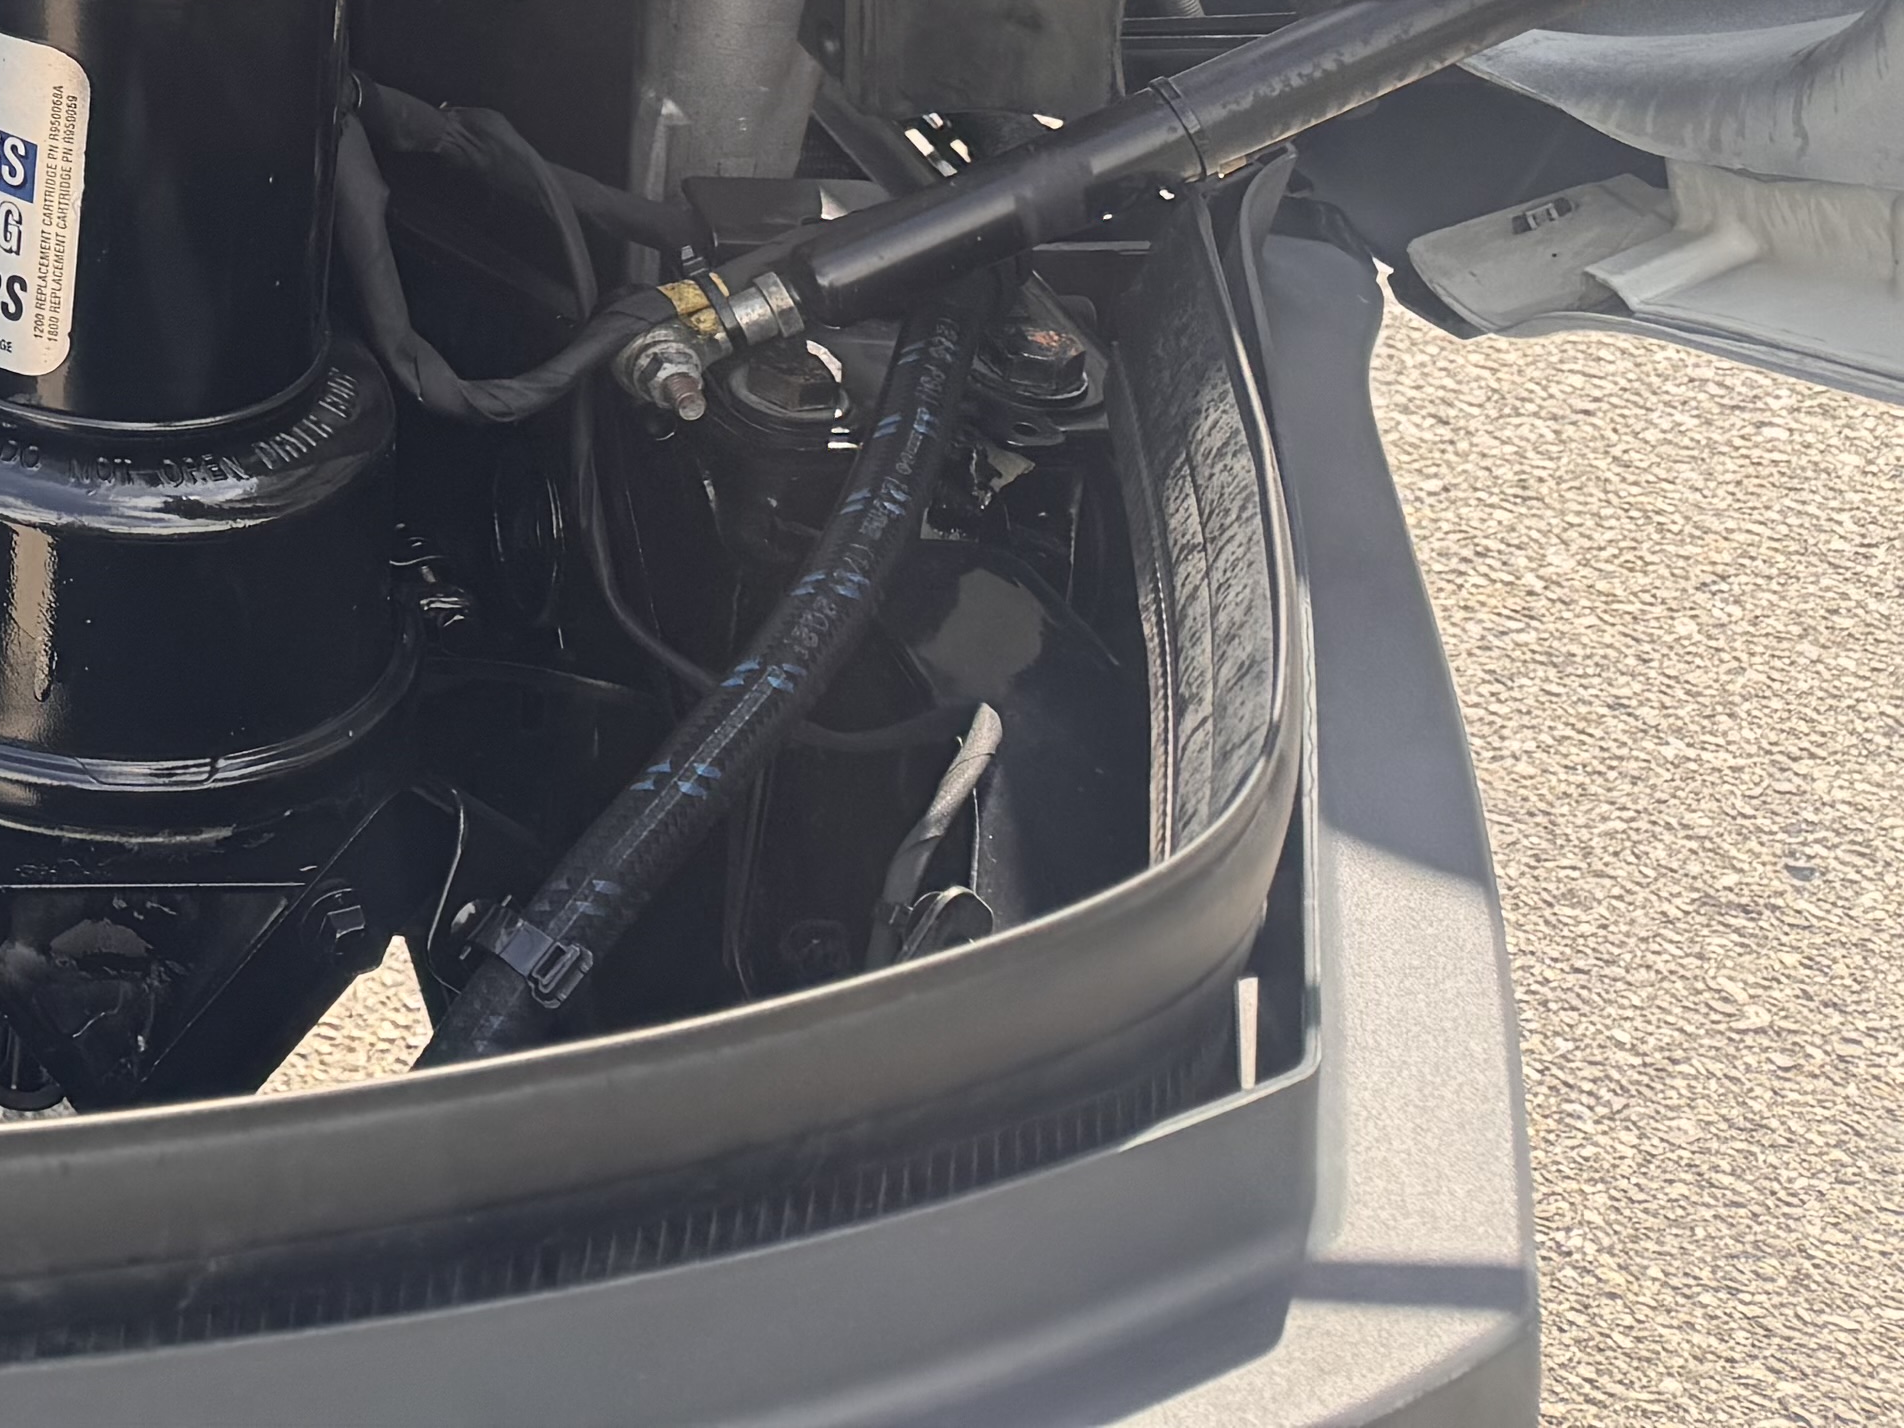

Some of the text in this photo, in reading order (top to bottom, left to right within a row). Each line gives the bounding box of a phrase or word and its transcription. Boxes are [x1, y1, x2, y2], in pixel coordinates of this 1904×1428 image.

[48, 144, 59, 161] PN
[43, 162, 58, 228] CARTRIDGE
[58, 165, 73, 231] CARTRIDGE
[35, 231, 52, 311] REPLACEMENT
[50, 234, 67, 316] REPLACEMENT
[33, 313, 46, 340] 1200
[47, 317, 59, 342] 1800
